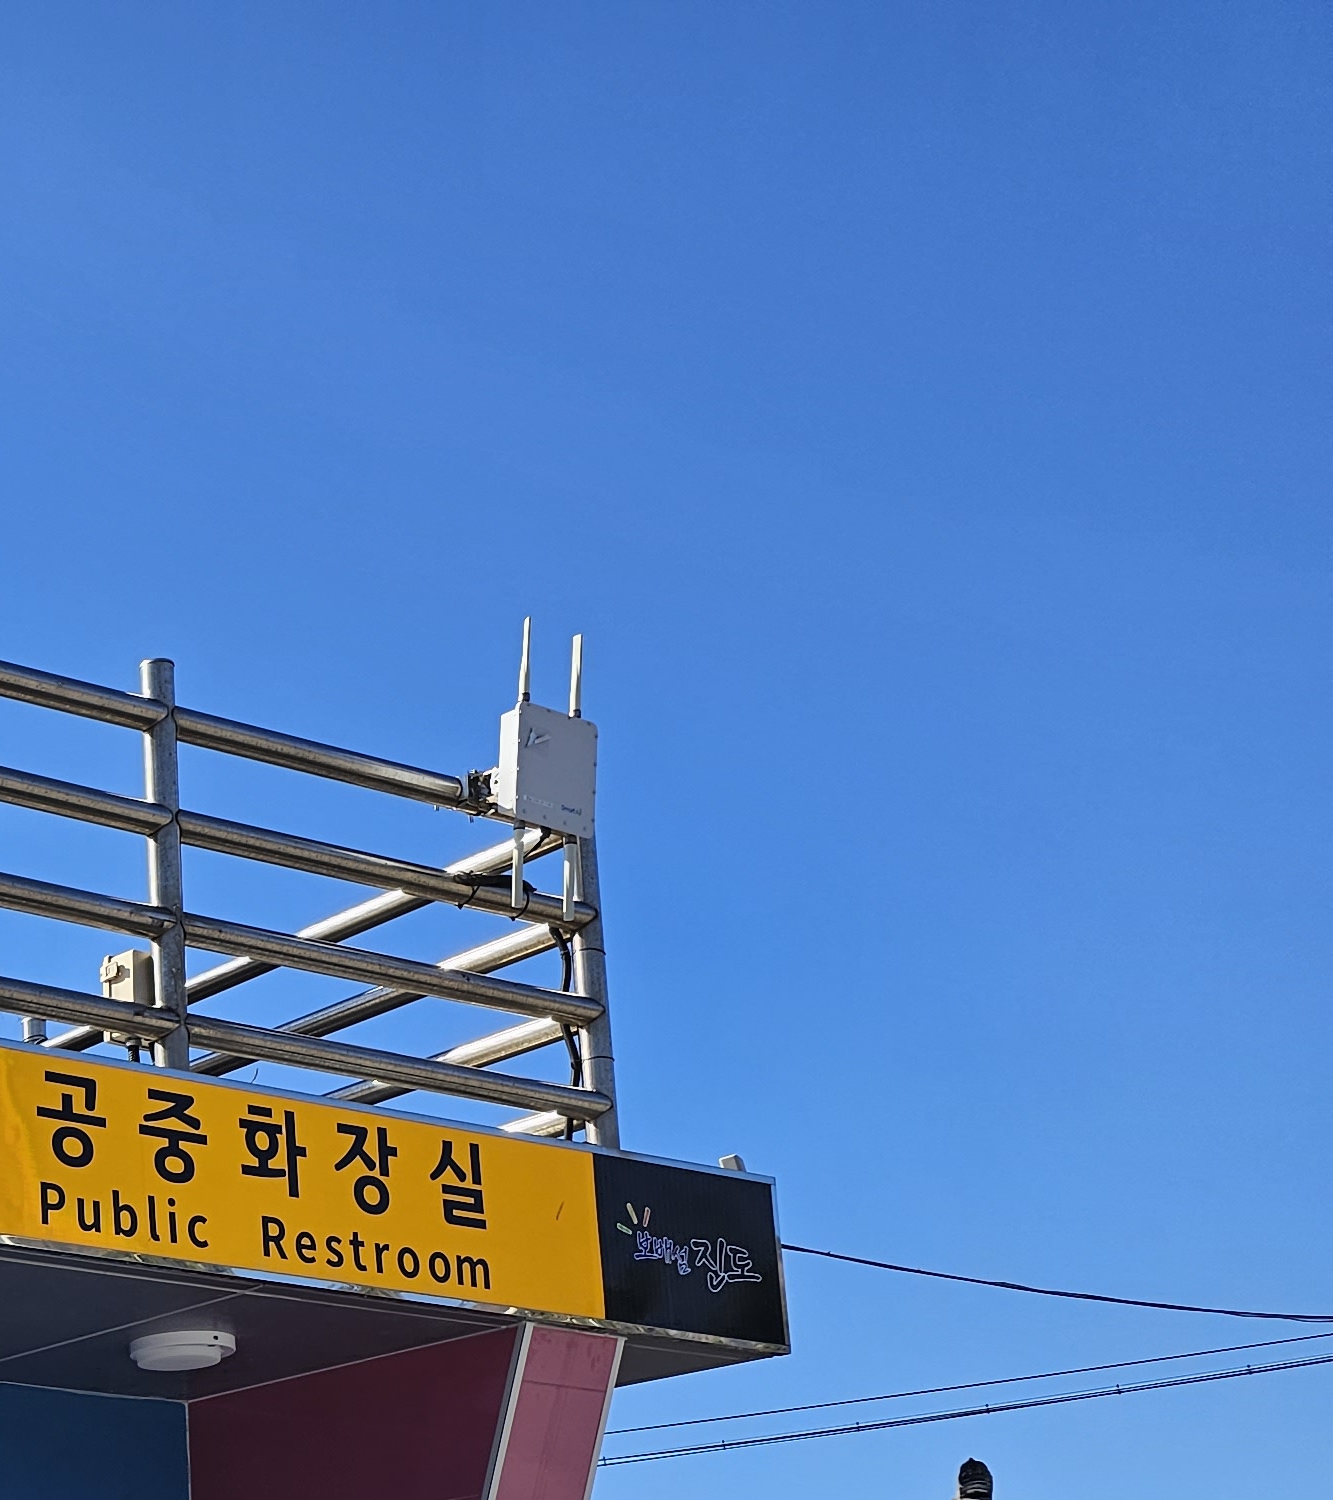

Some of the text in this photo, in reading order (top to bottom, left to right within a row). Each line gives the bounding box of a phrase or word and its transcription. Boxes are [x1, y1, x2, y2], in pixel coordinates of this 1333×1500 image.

[36, 1070, 488, 1231] 공중화장실
[39, 1181, 492, 1291] Public Restroom
[634, 1230, 763, 1293] 보배섬 진도
